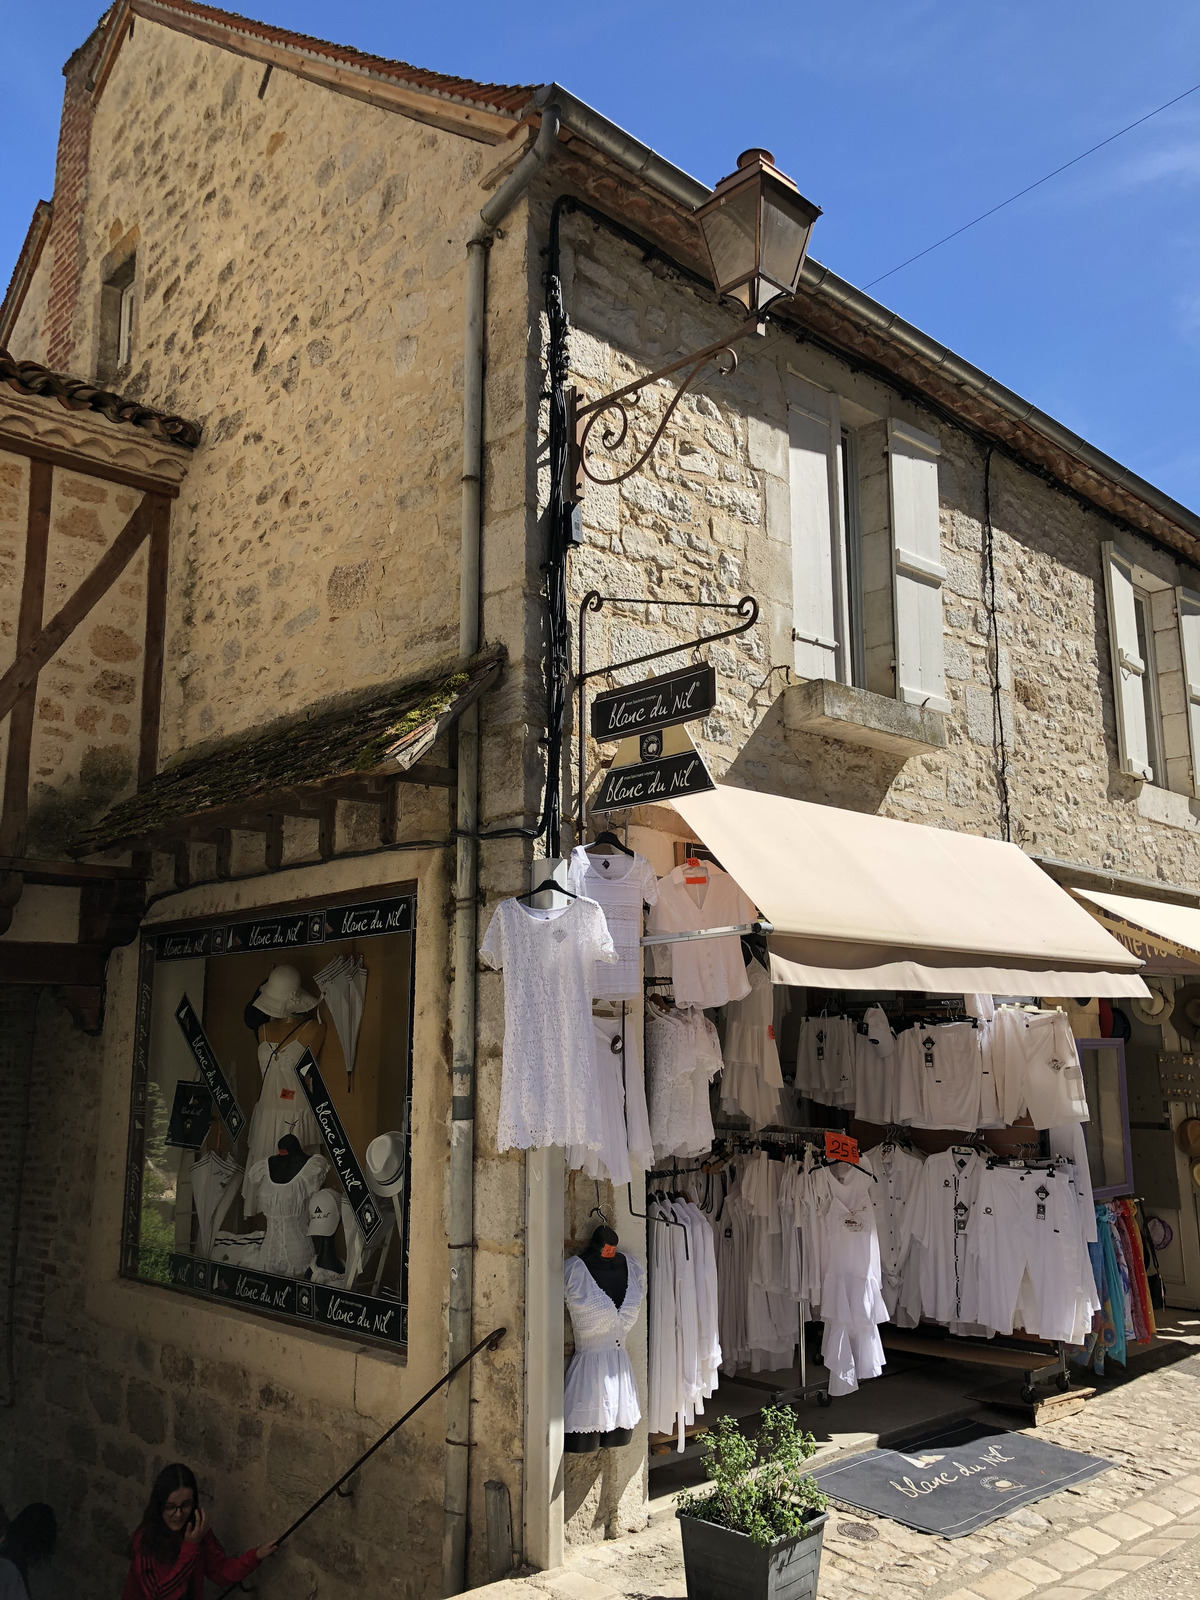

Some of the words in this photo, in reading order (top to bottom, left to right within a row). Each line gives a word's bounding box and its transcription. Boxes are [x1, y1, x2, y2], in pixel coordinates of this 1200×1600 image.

[608, 701, 646, 729] blanc
[650, 694, 668, 718] du
[605, 776, 643, 803] blanc
[648, 771, 666, 794] du
[249, 926, 271, 947] blanc
[272, 926, 283, 944] du
[341, 911, 368, 934] blanc
[370, 909, 383, 929] du
[191, 1034, 208, 1070] blanc
[205, 1070, 217, 1087] du
[315, 1101, 335, 1145] blanc
[332, 1146, 346, 1167] du
[235, 1274, 258, 1300] blanc
[260, 1283, 271, 1303] du
[326, 1294, 355, 1324] blanc
[356, 1306, 371, 1329] du
[889, 1472, 959, 1498] blanc
[952, 1461, 987, 1477] du
